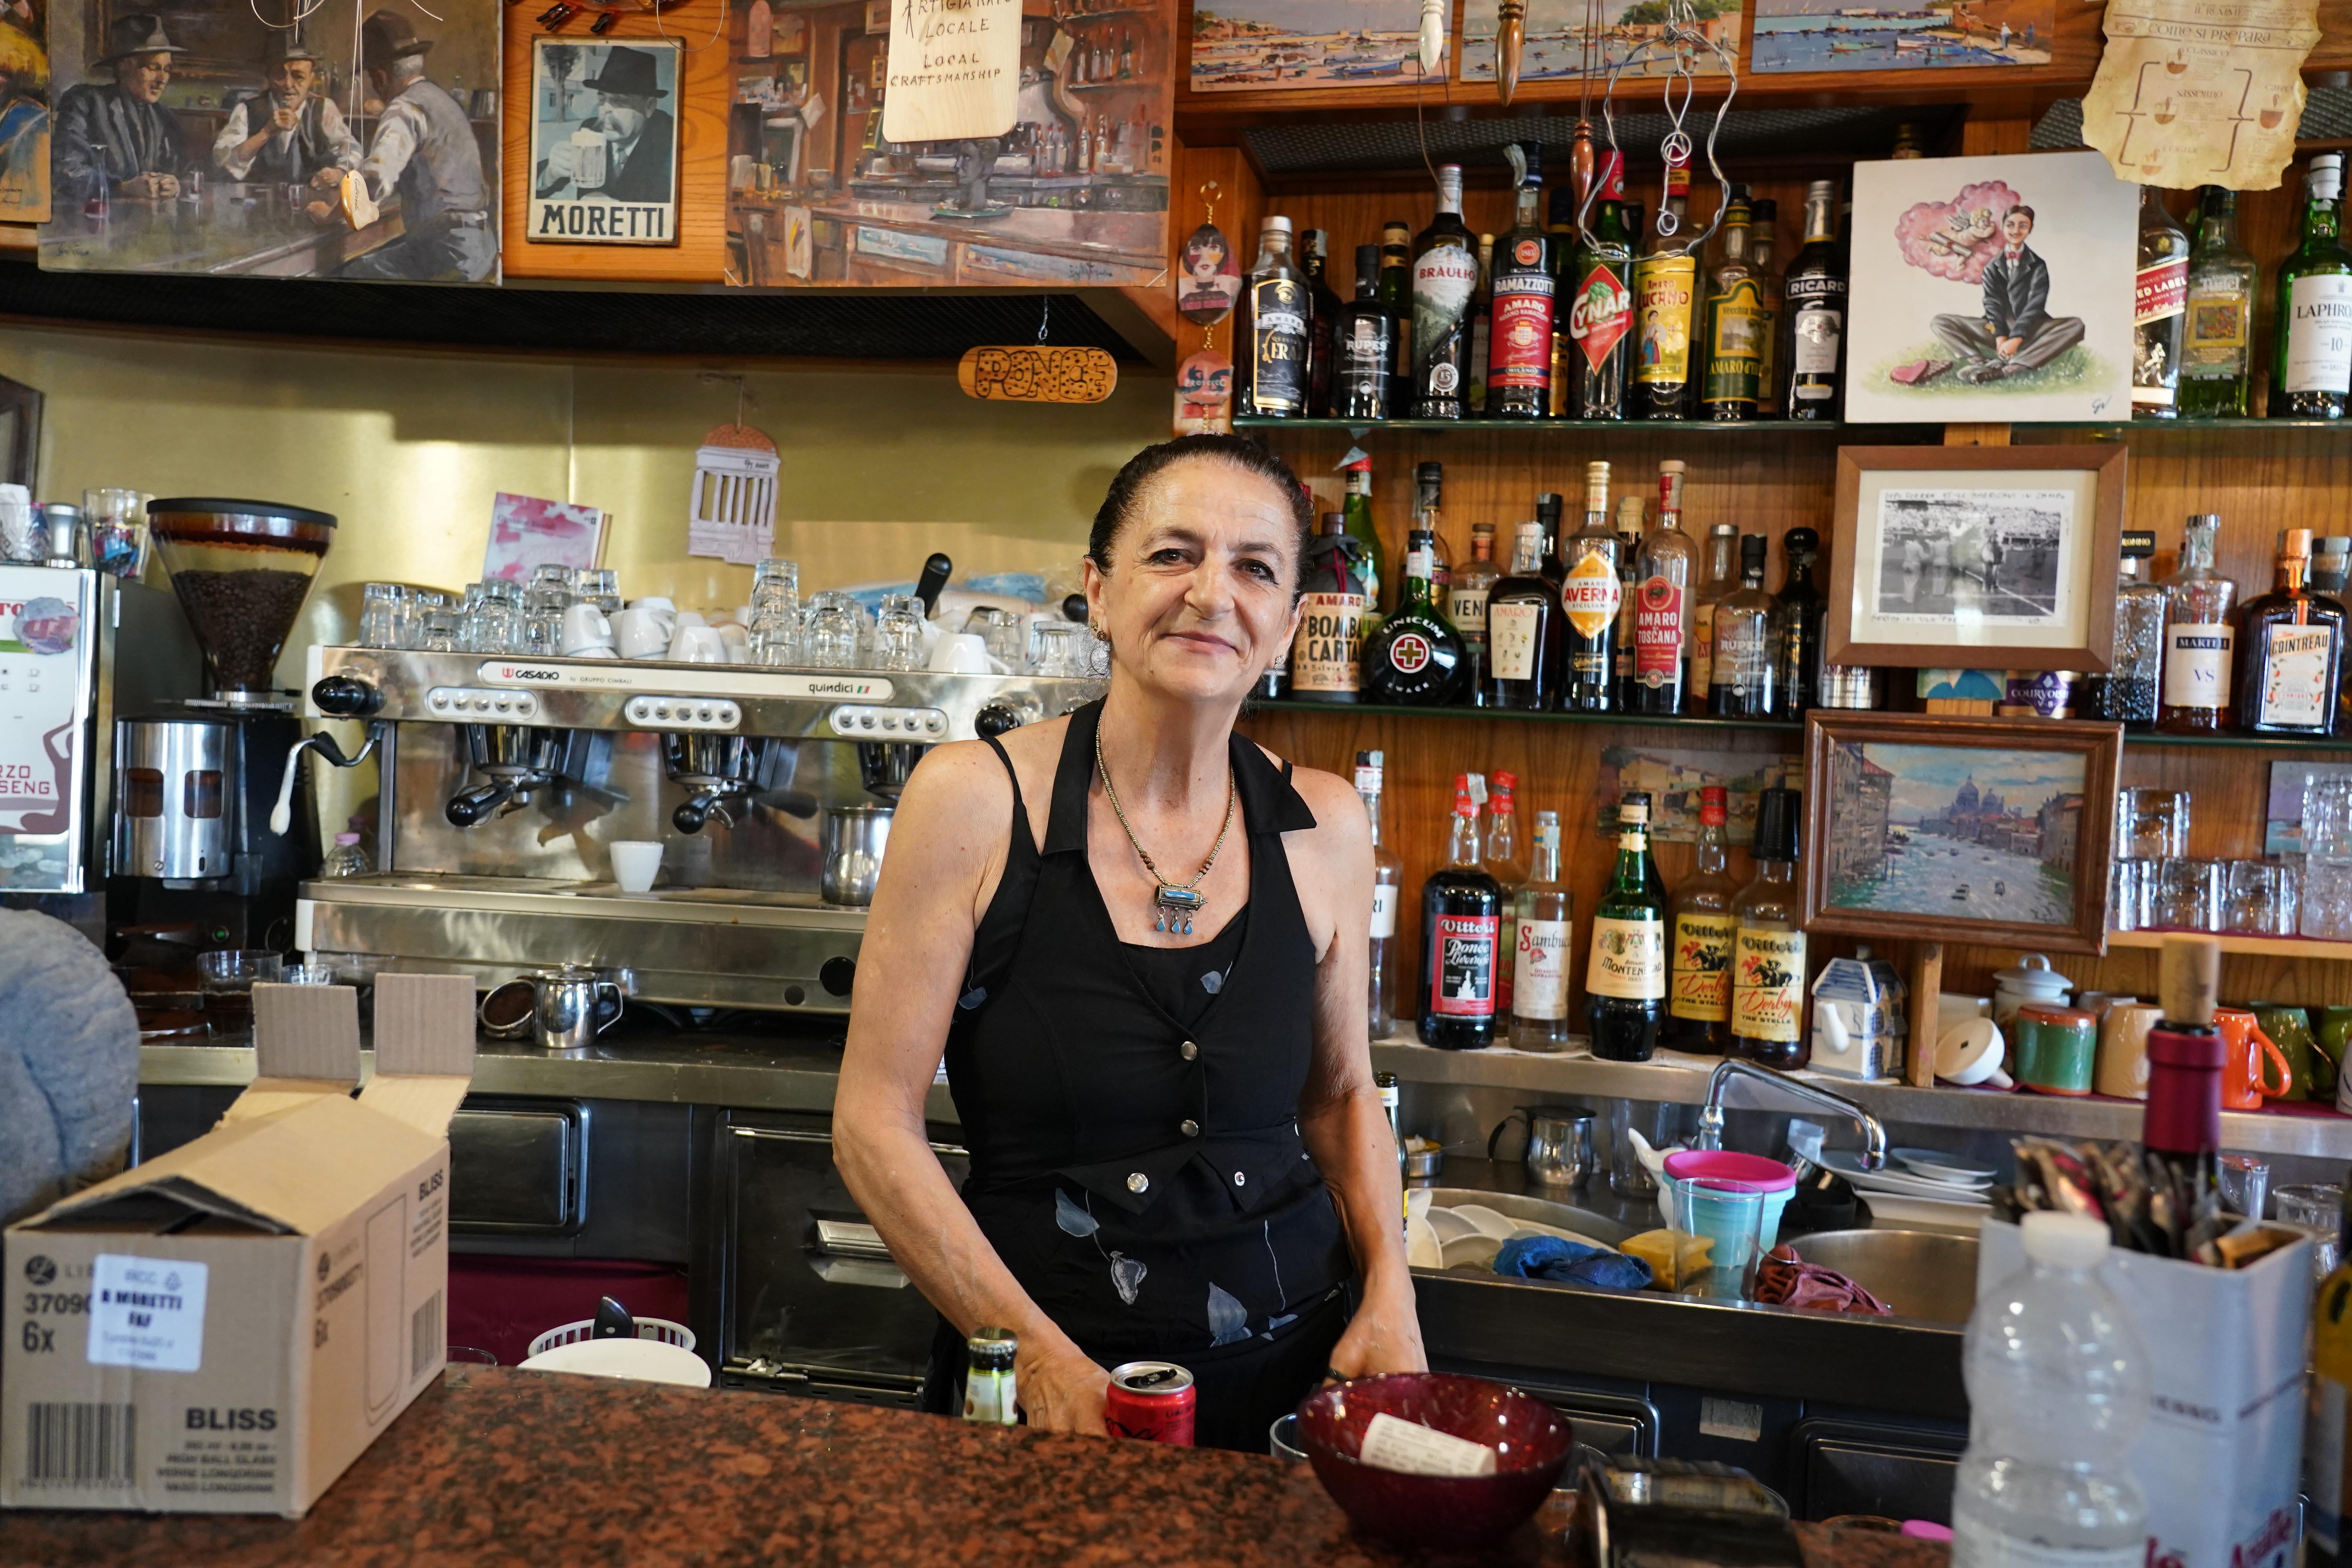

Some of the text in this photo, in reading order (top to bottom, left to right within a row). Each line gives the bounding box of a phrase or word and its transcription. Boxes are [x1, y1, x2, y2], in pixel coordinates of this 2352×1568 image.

[926, 18, 989, 38] LOCALE
[924, 53, 979, 68] LOCAL
[890, 69, 1000, 87] CRAFTSMANSHIP
[540, 204, 664, 238] MORETTI
[1790, 280, 1846, 295] RICARD
[2154, 276, 2187, 294] LABEL
[1504, 299, 1546, 313] AMARO
[1637, 291, 1689, 312] LUCANO
[1570, 290, 1631, 339] CYNAR
[1345, 340, 1388, 352] RUPES
[2331, 338, 2343, 351] 10
[975, 348, 1110, 401] PONCE
[1709, 359, 1744, 374] AMARO
[1316, 595, 1361, 607] AMARO
[1564, 588, 1619, 603] AVERNA
[1494, 607, 1533, 618] AMARO
[1638, 612, 1677, 626] AMARO
[1382, 615, 1447, 639] UNICUM
[1638, 630, 1677, 644] TOSCANA
[2272, 634, 2328, 655] COINTREAU
[1309, 640, 1360, 662] CARTA
[515, 670, 560, 681] CASADIO
[2194, 669, 2215, 681] VS
[809, 682, 853, 694] quindici
[0, 765, 30, 778] ZO
[0, 780, 50, 794] SENG
[1441, 918, 1495, 935] Vittori
[1445, 939, 1490, 957] Ponce
[1741, 936, 1802, 954] Vittori
[1602, 955, 1662, 976] MONTENEGRO
[1739, 988, 1792, 1018] Derby
[419, 1169, 443, 1202] BLISS
[22, 1319, 55, 1352] 6x
[187, 1407, 276, 1430] BLISS
